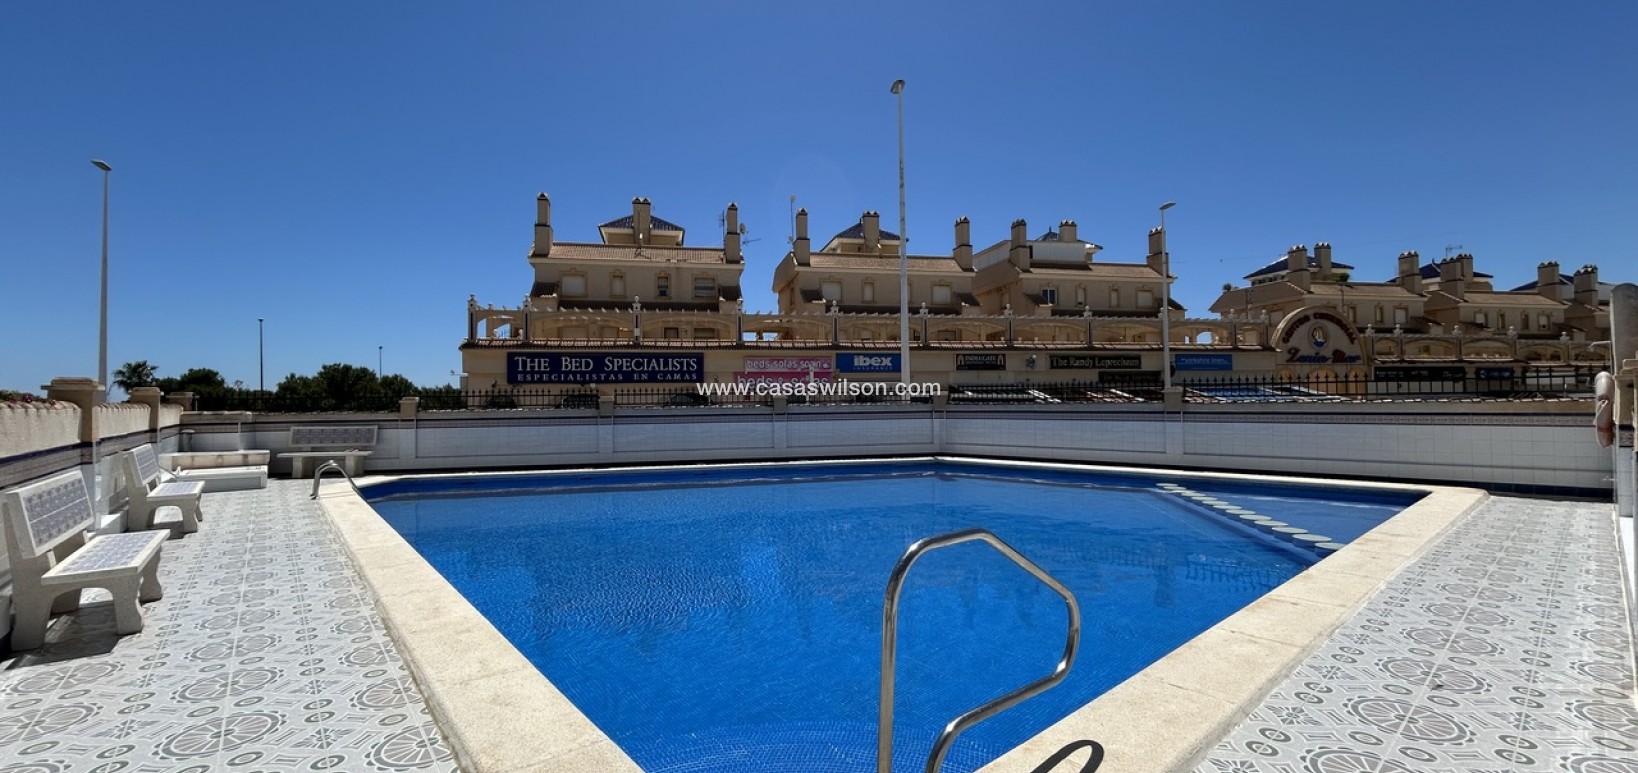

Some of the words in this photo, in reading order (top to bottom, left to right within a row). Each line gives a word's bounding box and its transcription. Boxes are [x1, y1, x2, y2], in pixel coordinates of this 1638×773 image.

[514, 356, 550, 371] THE
[561, 356, 594, 371] BED
[604, 356, 697, 371] SPECIALISTS
[853, 355, 892, 366] ibex
[1053, 357, 1068, 366] The
[1069, 357, 1094, 368] Randy
[517, 373, 624, 381] ESPECIALISTAS
